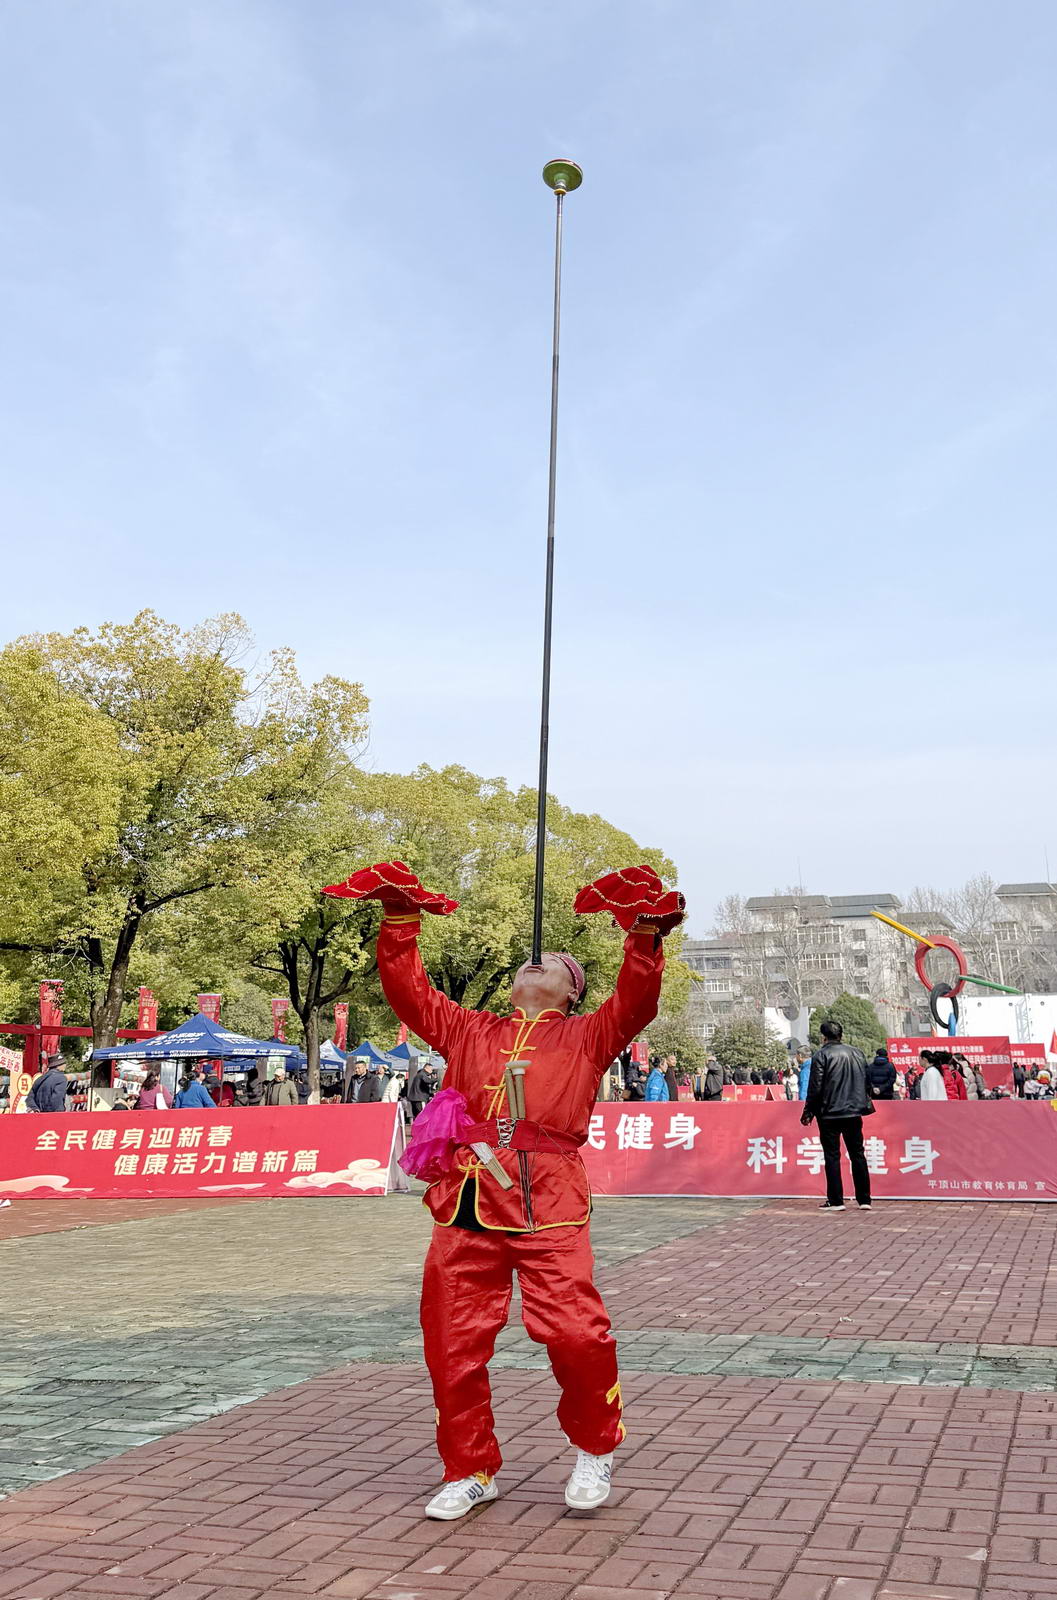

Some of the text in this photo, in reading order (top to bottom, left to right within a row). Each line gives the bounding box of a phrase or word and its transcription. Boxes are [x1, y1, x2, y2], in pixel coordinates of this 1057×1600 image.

[35, 1125, 233, 1151] 全民健身迎新春
[114, 1149, 319, 1176] 健康活力谱新篇
[928, 1179, 1046, 1190] 平顶山市教育体育局 宣
